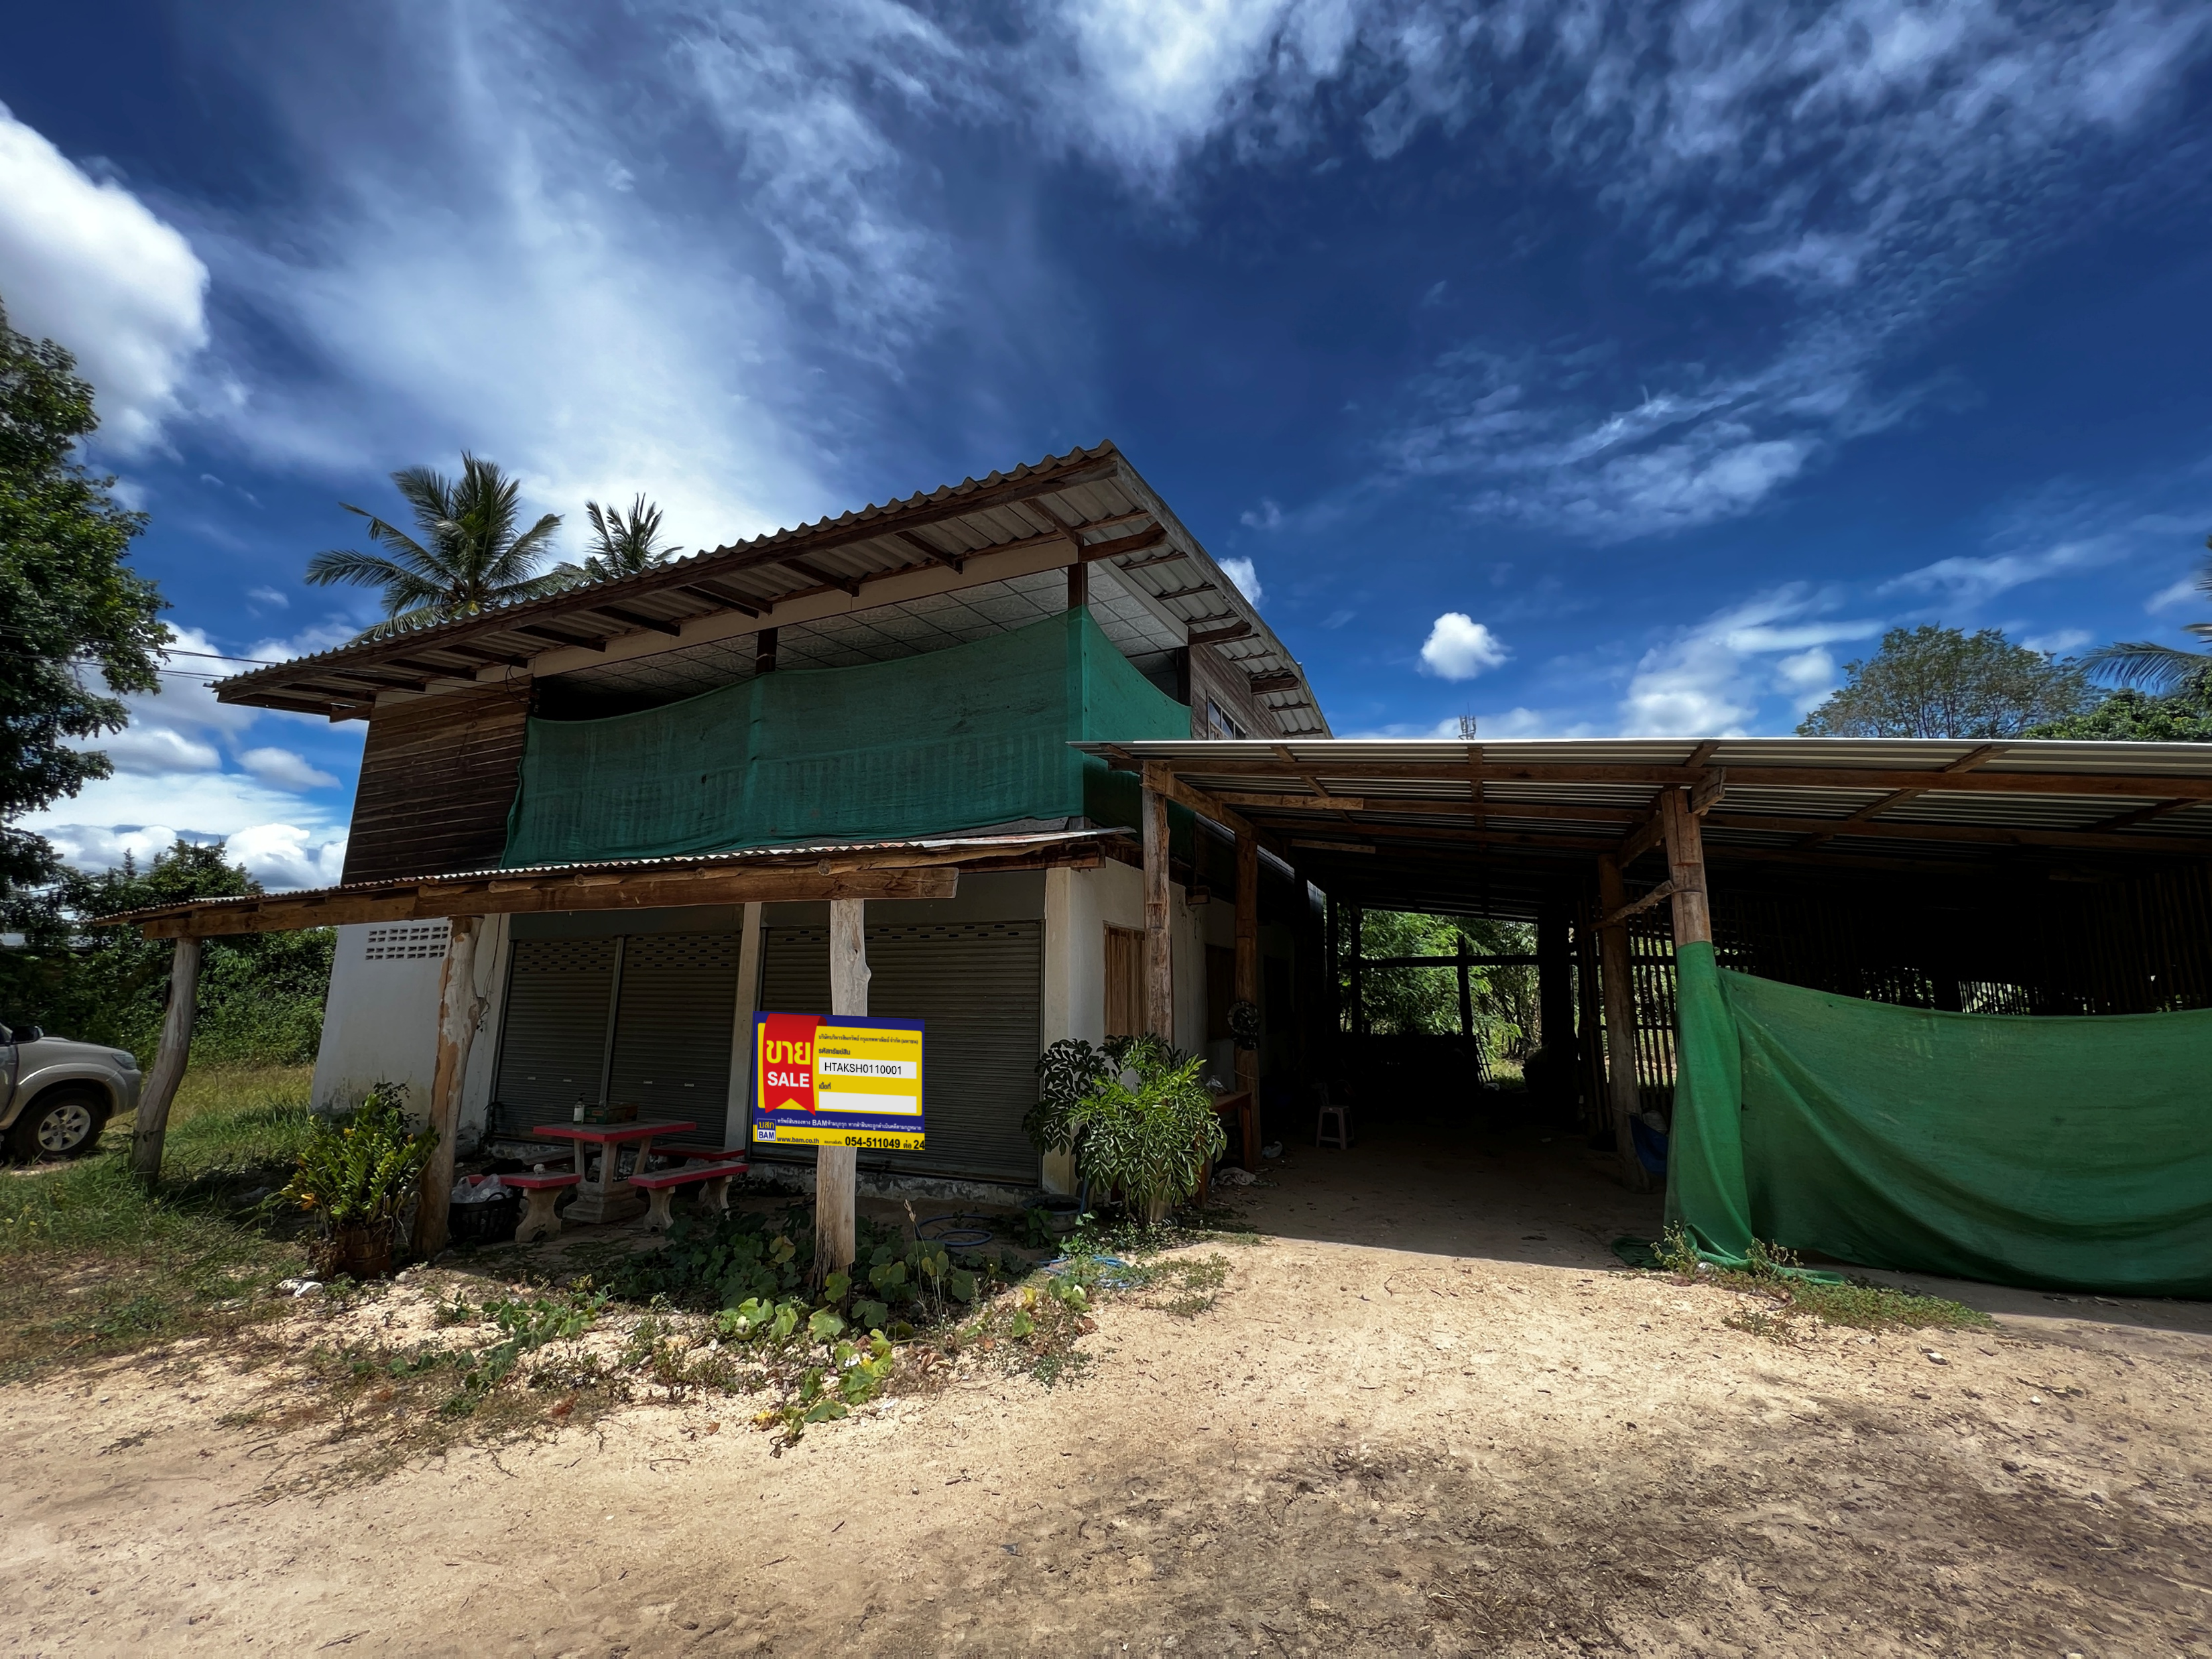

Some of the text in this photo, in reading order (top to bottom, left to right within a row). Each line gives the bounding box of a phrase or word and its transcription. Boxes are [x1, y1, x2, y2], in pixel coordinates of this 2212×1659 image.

[766, 1040, 810, 1065] ขาย
[818, 1047, 851, 1055] รหัสทรัพย์สิน
[824, 1062, 902, 1075] HTAKSH0110001
[767, 1071, 810, 1087] SALE
[818, 1081, 831, 1090] เนื้อที่
[758, 1121, 774, 1129] บสก
[759, 1131, 774, 1139] BAM
[845, 1136, 900, 1148] 054-511049
[903, 1140, 912, 1149] ต่อ
